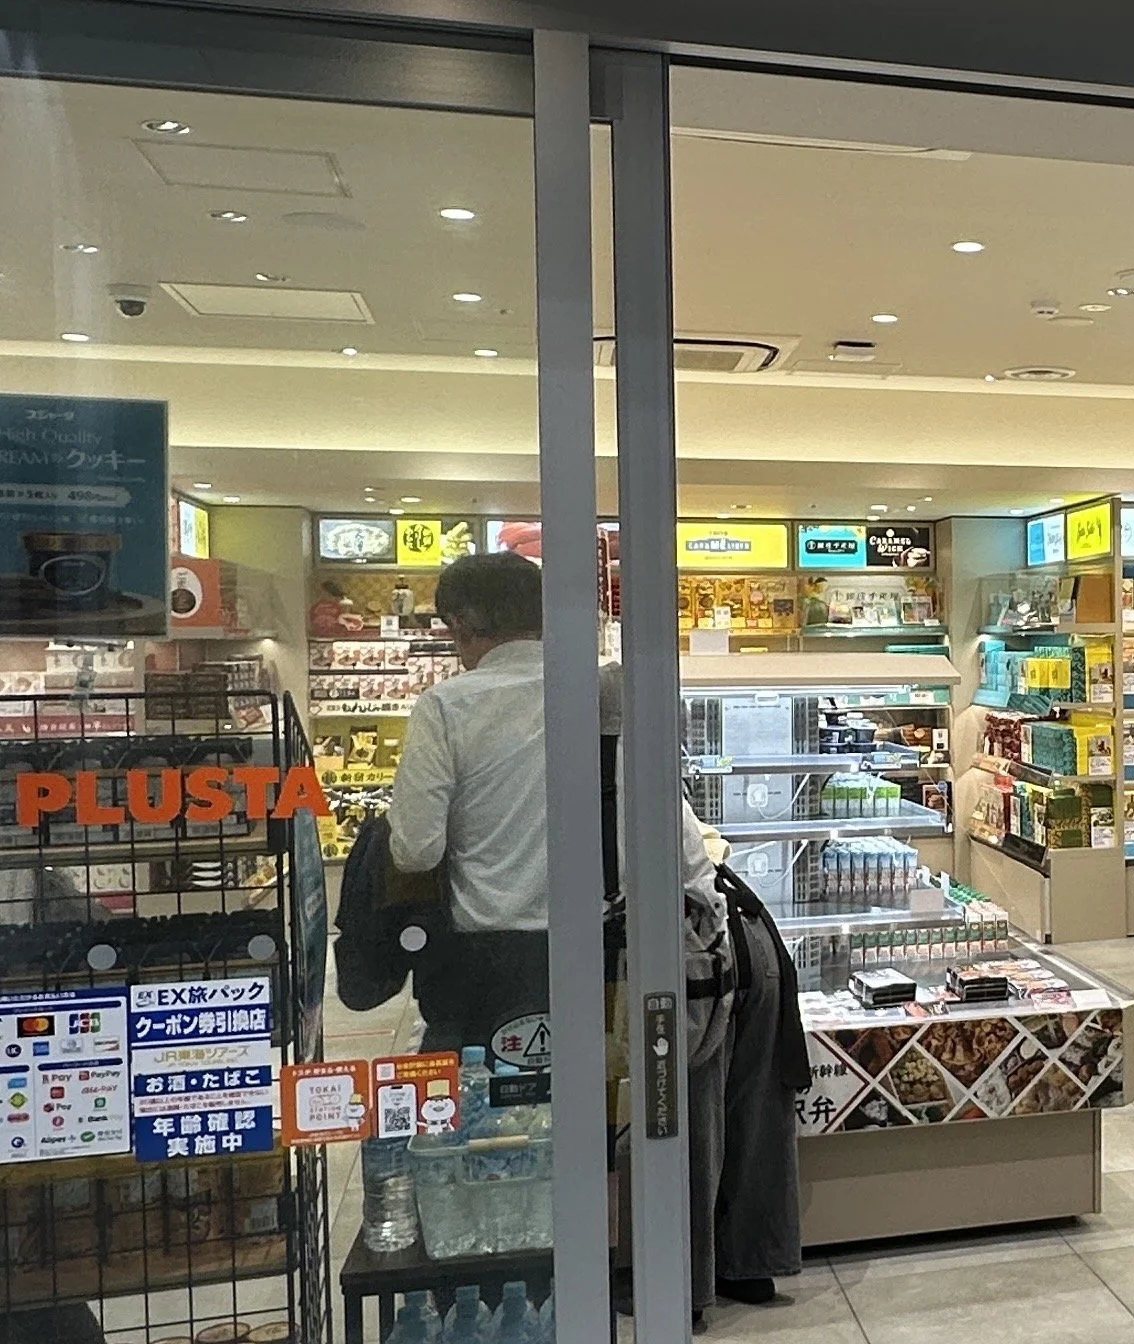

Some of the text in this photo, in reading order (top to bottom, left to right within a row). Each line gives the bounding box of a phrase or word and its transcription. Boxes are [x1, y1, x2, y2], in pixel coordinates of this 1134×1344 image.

[15, 766, 333, 828] PLUSTA
[157, 981, 265, 1006] EX旅パック
[135, 1008, 267, 1038] クーポン券引換店
[500, 1034, 523, 1053] 注
[91, 1070, 121, 1080] PayPay
[145, 1069, 261, 1093] お酒・たばこ
[309, 1084, 342, 1095] TOKAI
[152, 1109, 256, 1137] 年齢確認
[309, 1112, 341, 1122] POINT
[167, 1132, 243, 1158] 実施中
